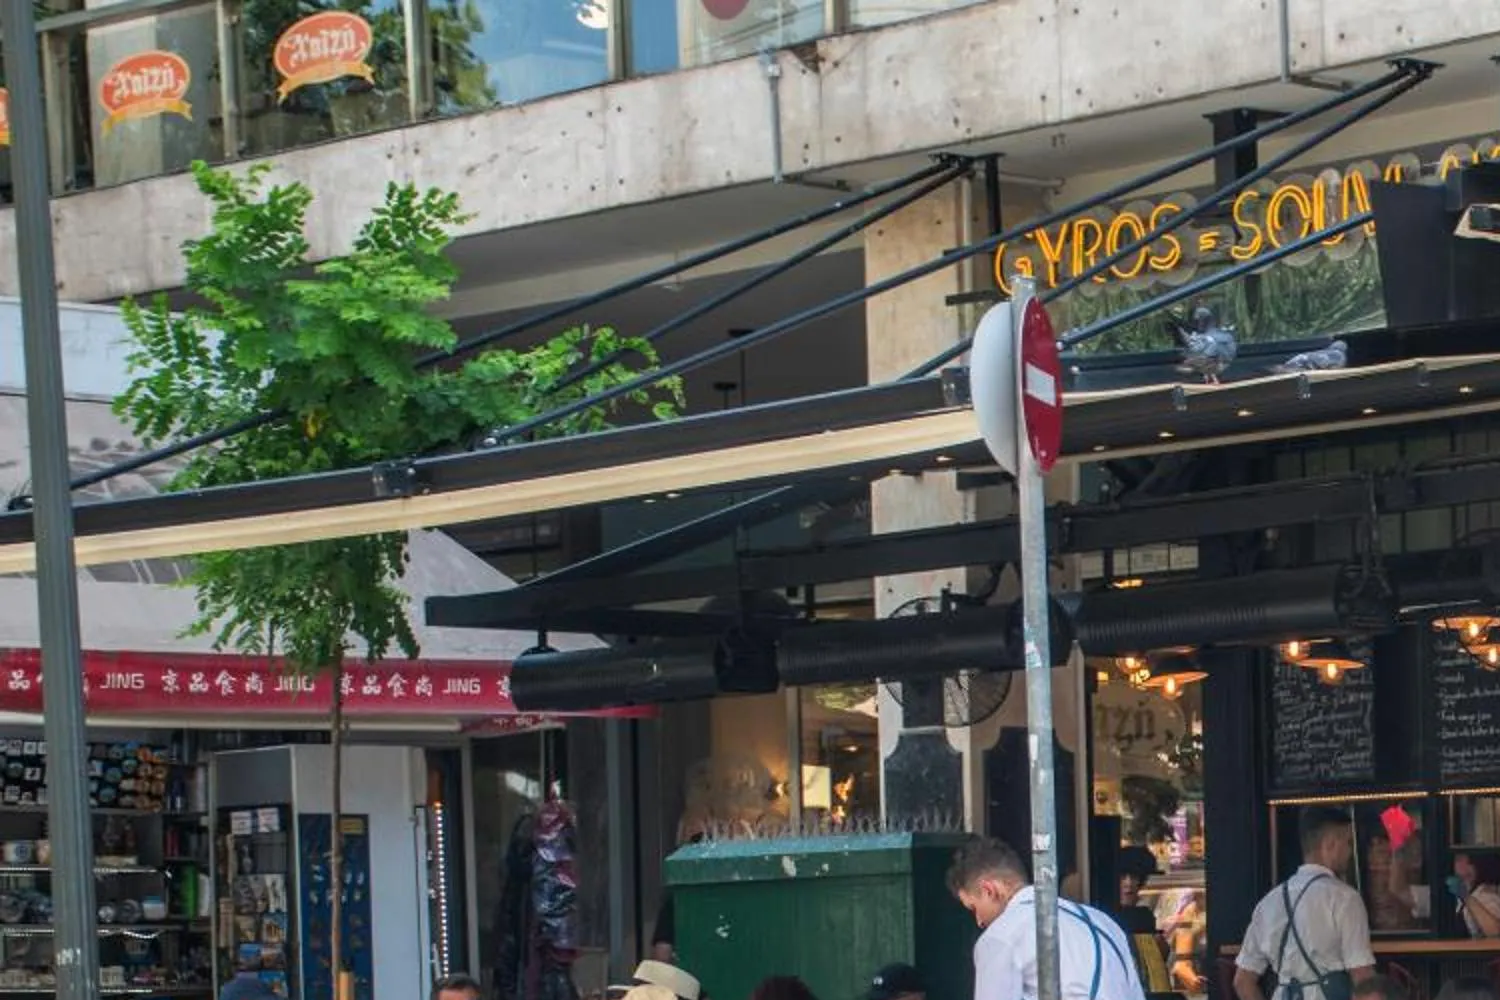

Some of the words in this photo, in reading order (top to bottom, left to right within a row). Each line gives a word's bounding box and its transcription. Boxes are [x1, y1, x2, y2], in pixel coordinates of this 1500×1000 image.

[994, 203, 1181, 296] GYROS
[100, 672, 145, 690] JING
[442, 674, 482, 695] JING
